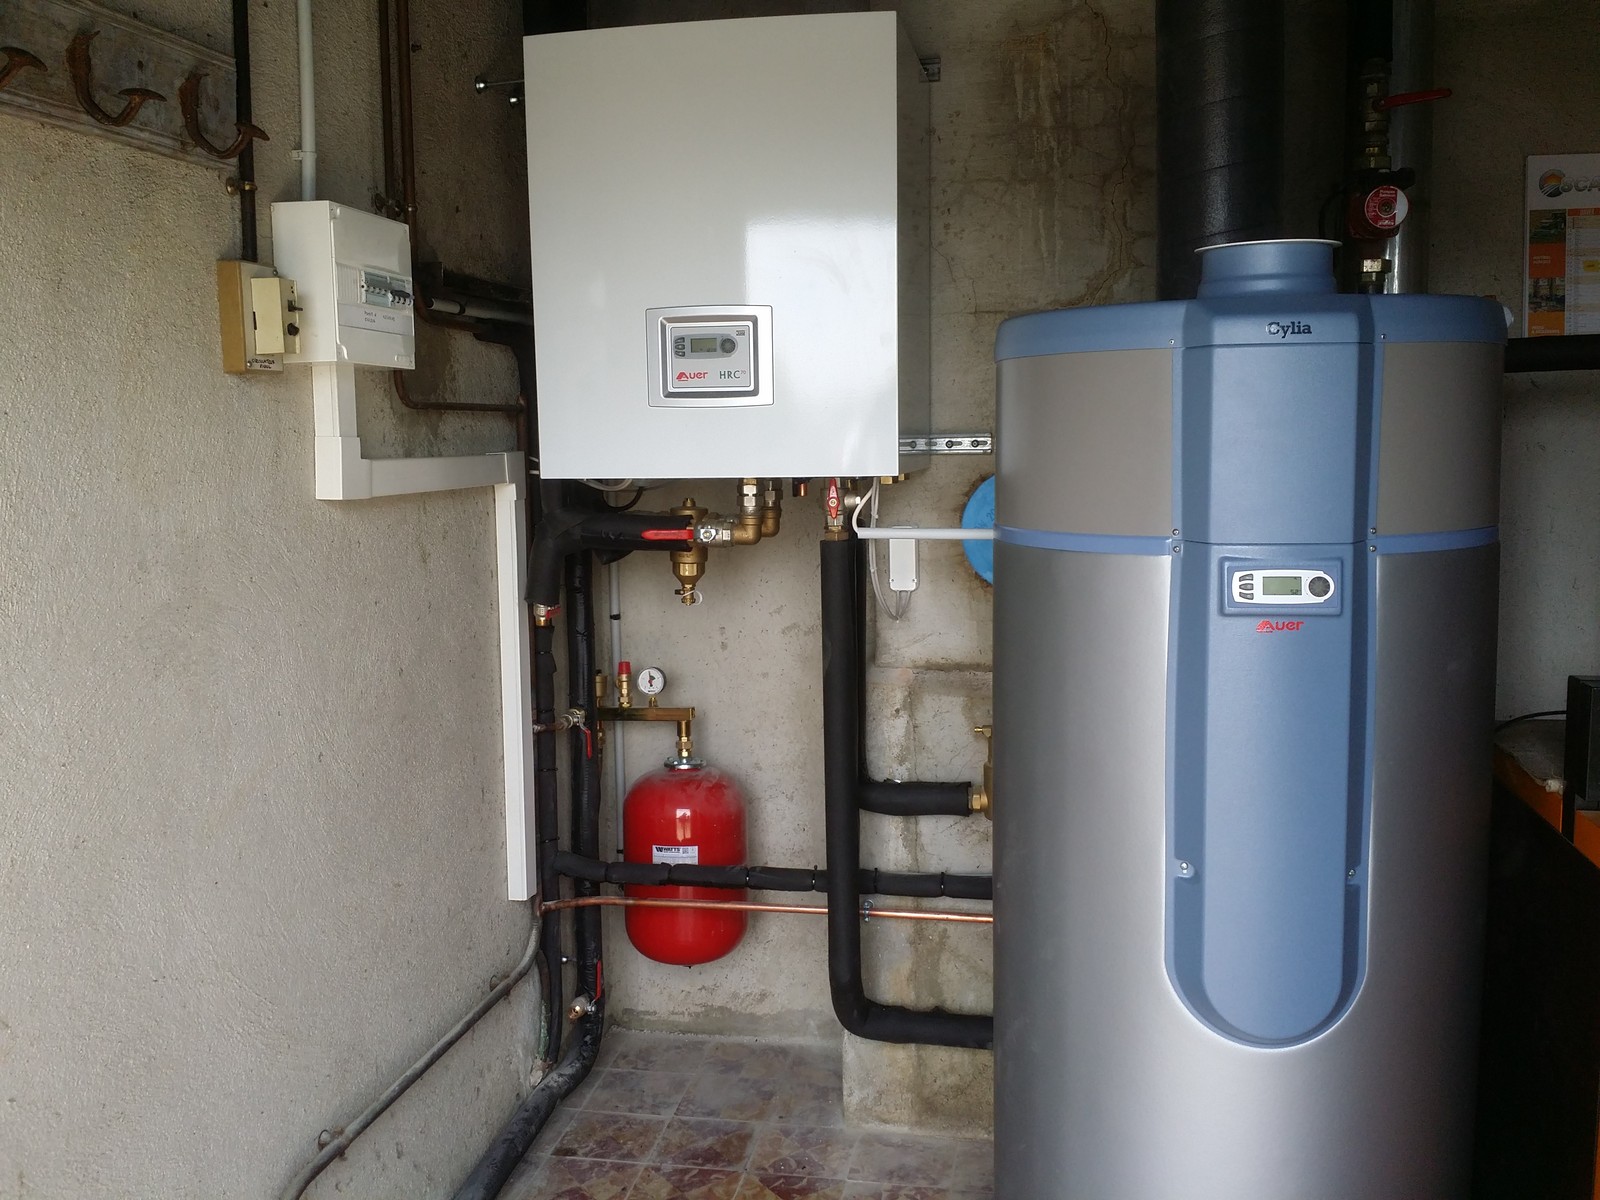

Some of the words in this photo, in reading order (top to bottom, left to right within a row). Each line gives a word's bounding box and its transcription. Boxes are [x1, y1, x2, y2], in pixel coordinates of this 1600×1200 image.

[1266, 321, 1312, 338] Cylia
[676, 371, 708, 381] Auer
[719, 370, 740, 379] HRC
[1256, 620, 1304, 633] Auer
